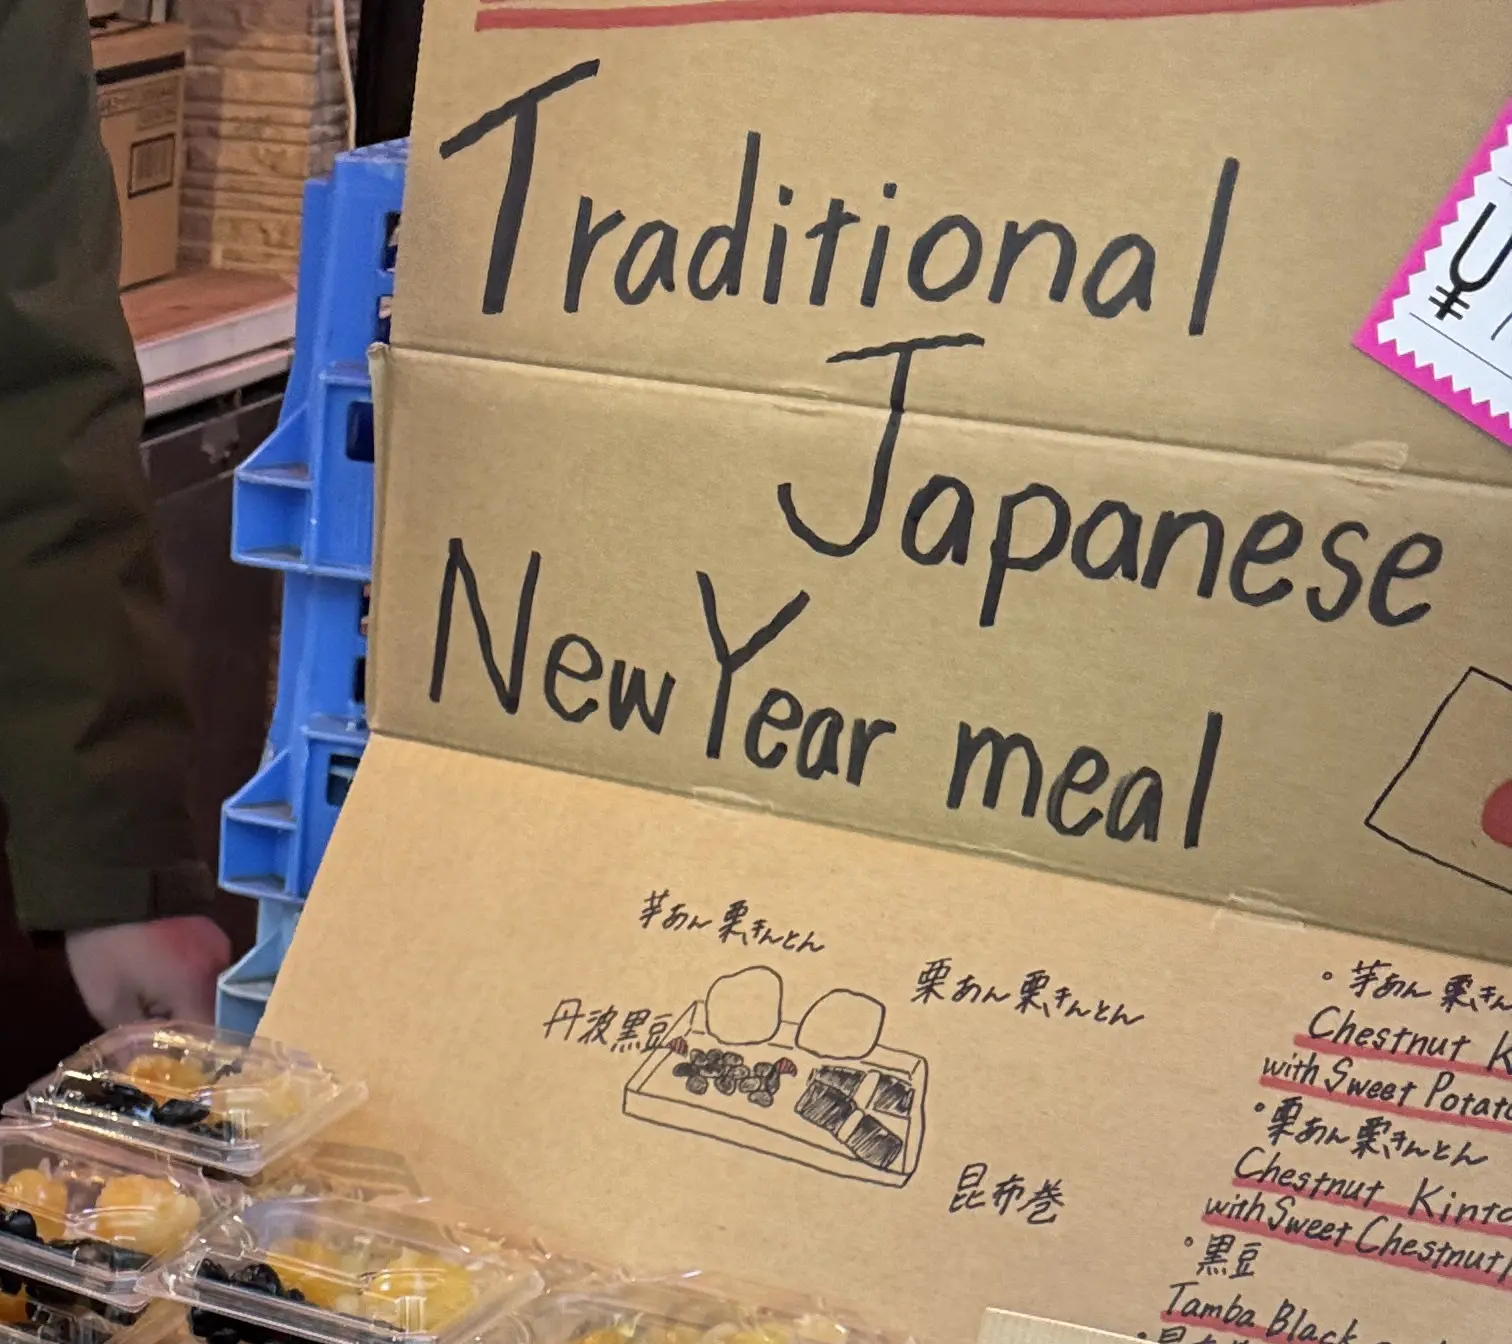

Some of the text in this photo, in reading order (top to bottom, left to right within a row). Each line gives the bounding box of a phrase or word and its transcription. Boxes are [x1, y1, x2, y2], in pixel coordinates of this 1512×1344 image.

[439, 58, 1239, 336] Traditional
[777, 333, 1444, 627] Japanese
[947, 710, 1223, 850] meal
[1307, 1005, 1472, 1063] Chestnut
[1261, 1052, 1320, 1086] with
[1324, 1056, 1418, 1108] Sweet
[948, 1162, 1066, 1225] 昆布巻
[1233, 1146, 1386, 1207] Chestnut
[1194, 1232, 1263, 1280] 黒豆
[1204, 1191, 1264, 1224] with
[1267, 1194, 1354, 1248] Sweet
[1354, 1214, 1505, 1275] Chestnut
[1164, 1281, 1257, 1328] Tamba
